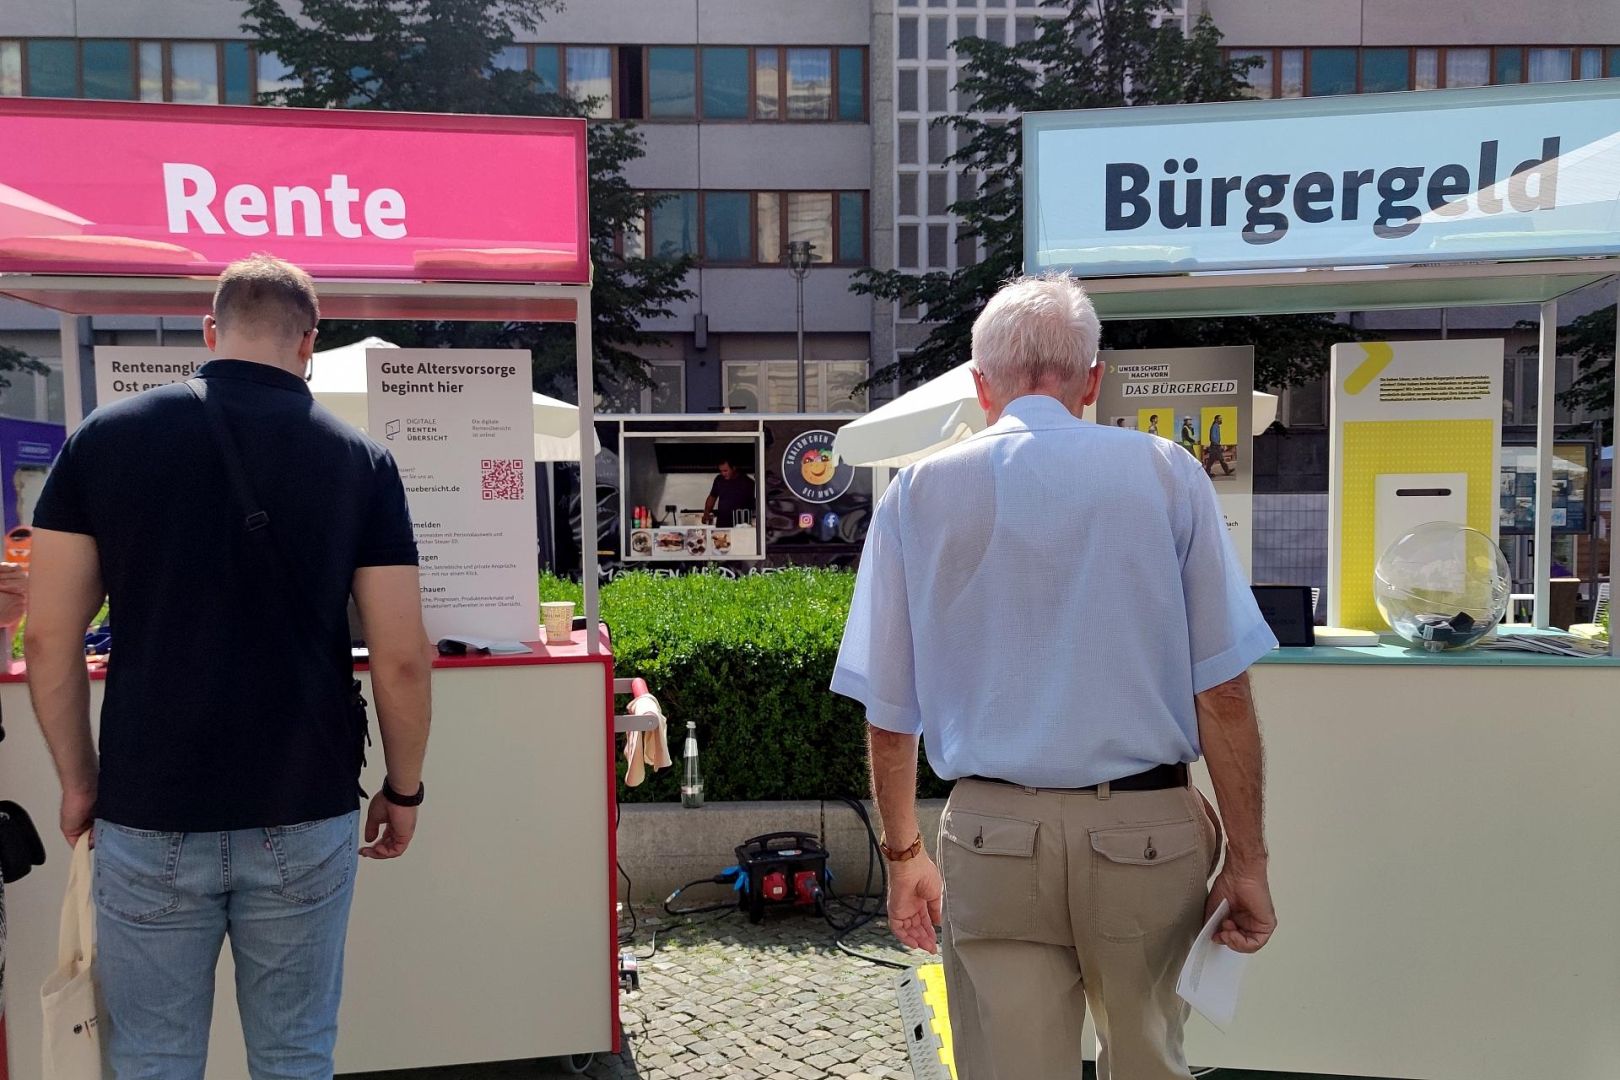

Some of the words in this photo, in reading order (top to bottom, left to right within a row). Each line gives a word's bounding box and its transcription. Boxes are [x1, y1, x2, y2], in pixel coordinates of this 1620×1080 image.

[1105, 136, 1561, 246] Bürgergeld
[163, 161, 407, 240] Rente
[381, 362, 414, 375] Gute
[417, 362, 516, 378] Altersvorsorge
[1141, 364, 1169, 372] SCHRITT
[113, 380, 139, 392] Ost
[381, 380, 434, 395] beginnt
[437, 380, 464, 393] hier
[1125, 384, 1149, 395] DAS
[1151, 381, 1235, 395] BÜRGERGELD
[405, 485, 460, 493] nuebersicht.de
[412, 521, 441, 529] melden
[418, 554, 439, 562] ragen
